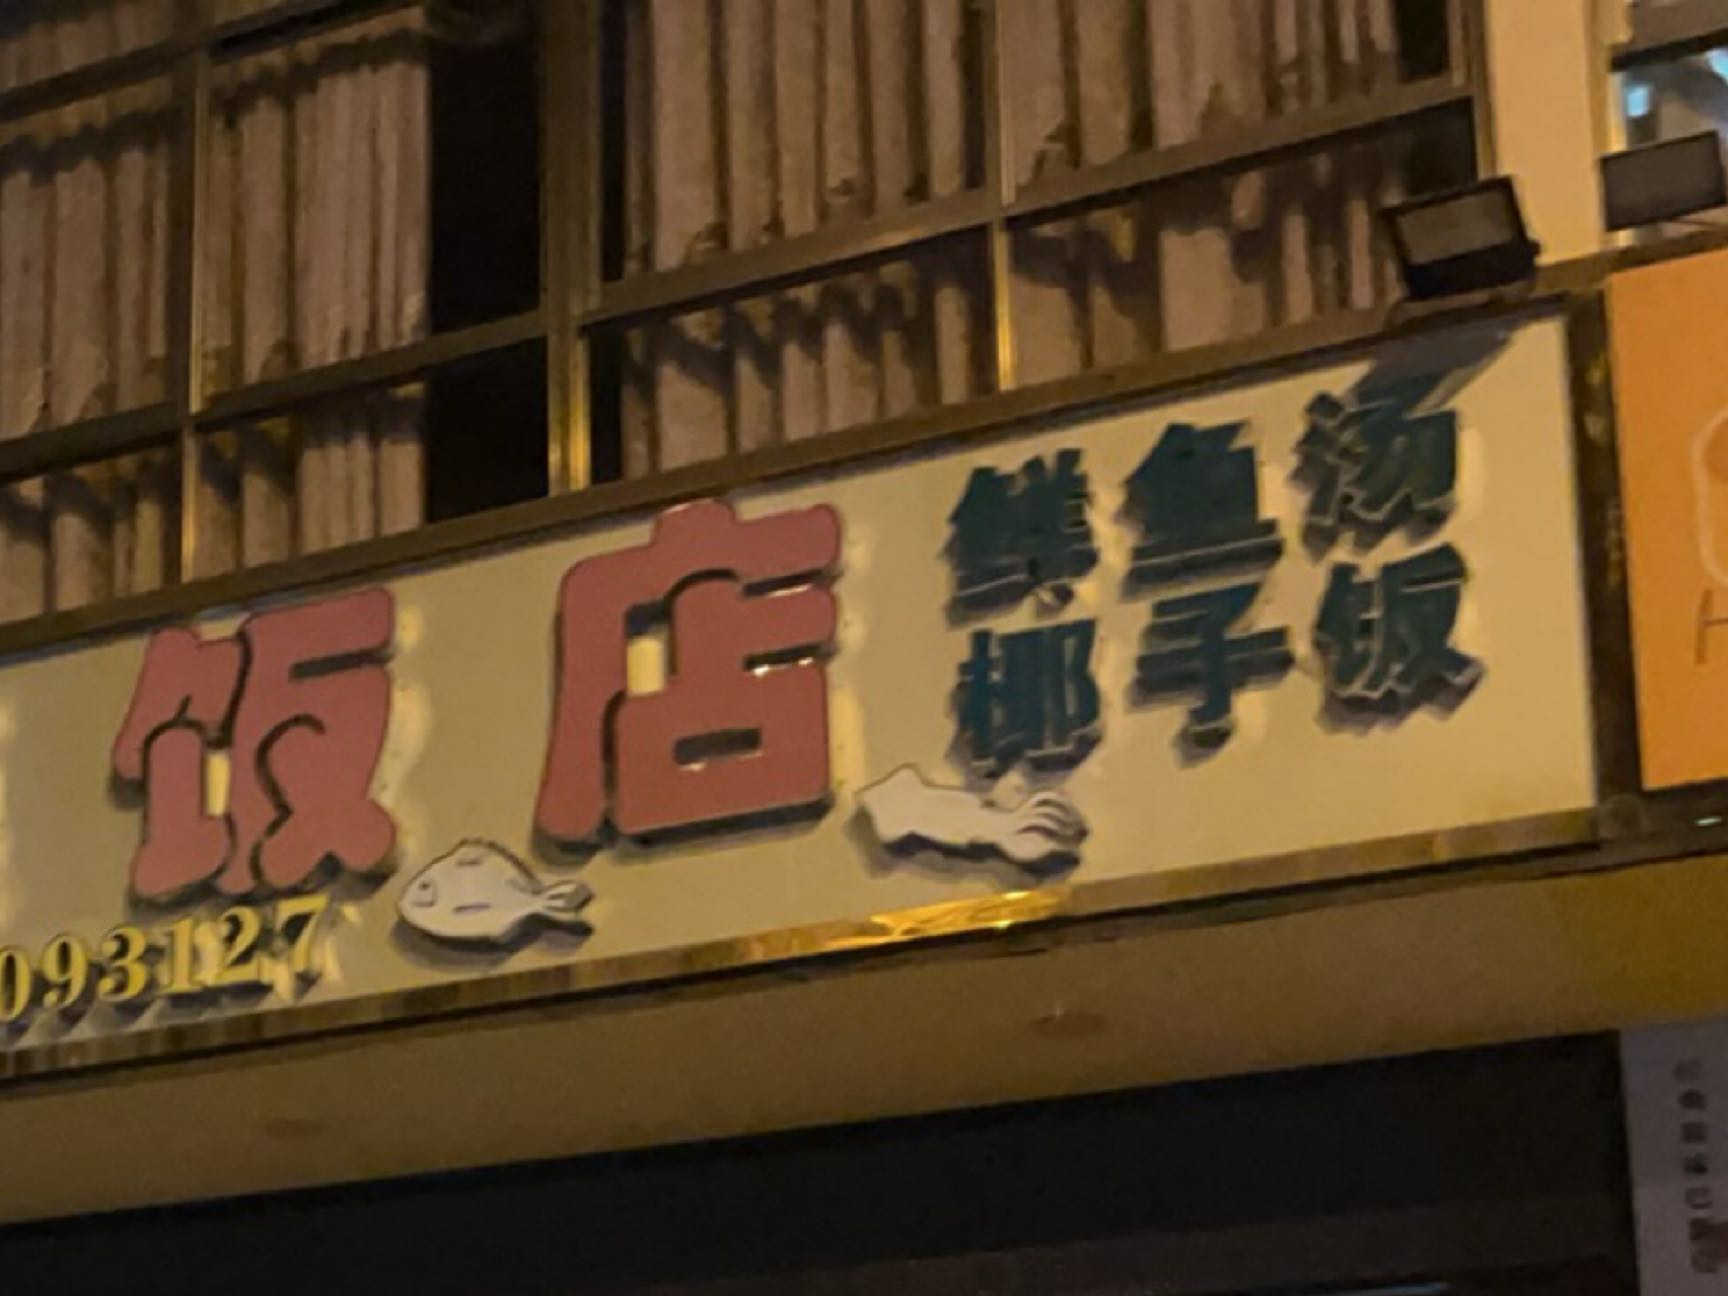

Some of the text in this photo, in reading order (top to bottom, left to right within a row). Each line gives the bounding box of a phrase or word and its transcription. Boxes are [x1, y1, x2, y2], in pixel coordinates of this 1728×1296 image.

[946, 393, 1462, 596] 鲜鱼汤
[955, 543, 1485, 766] 椰子饭
